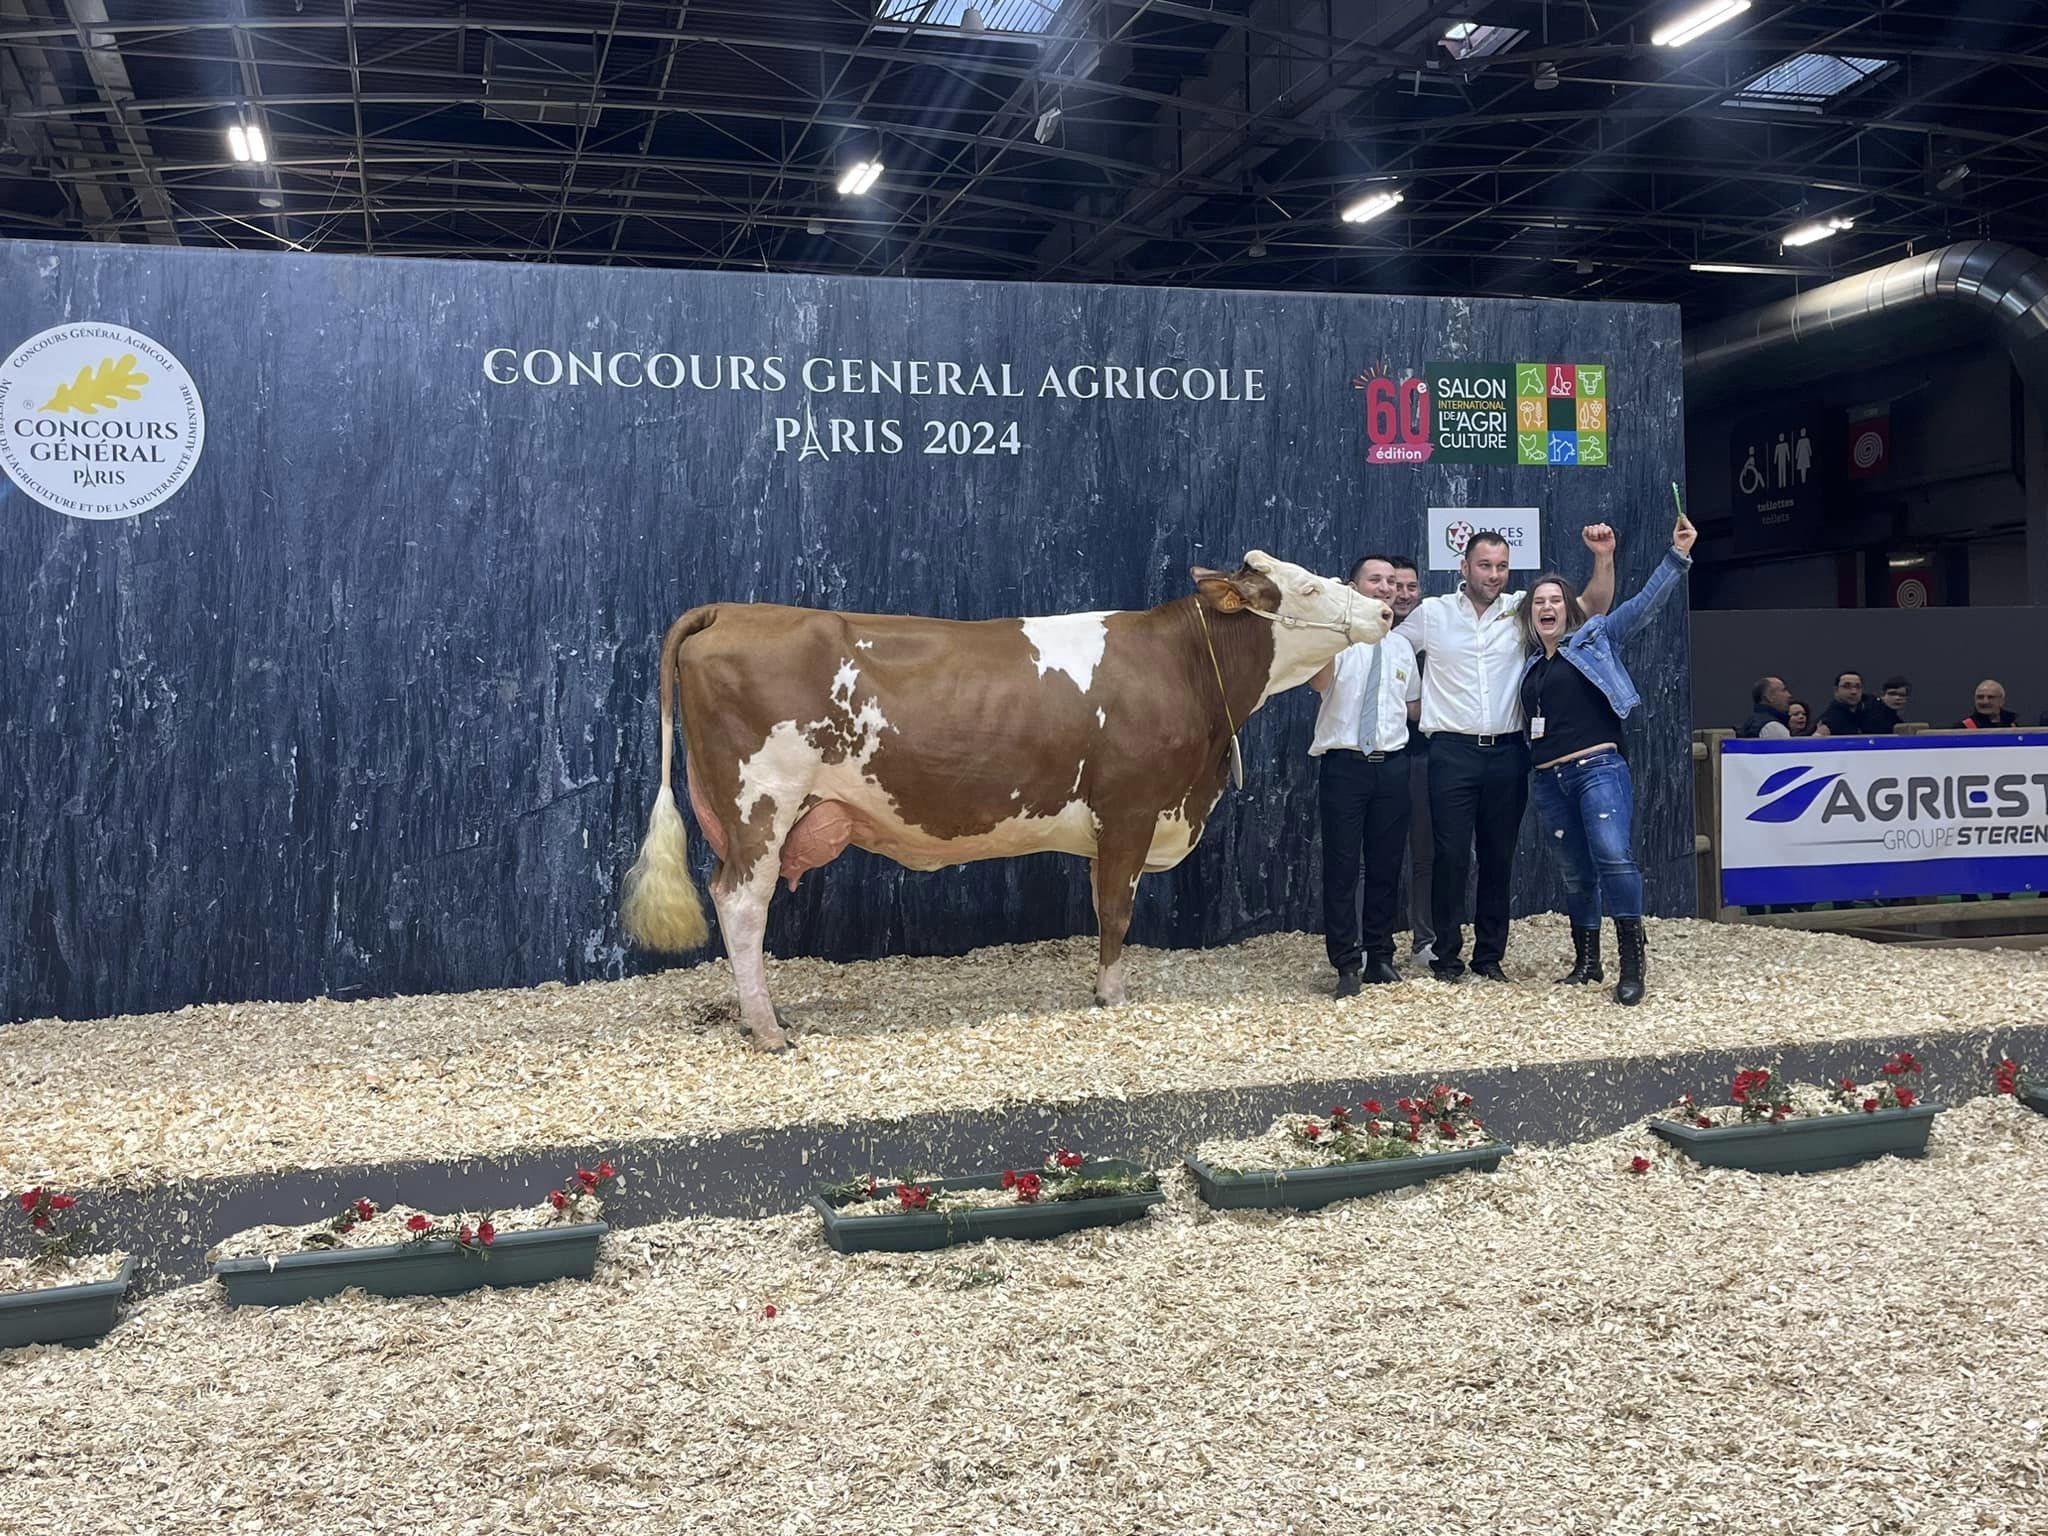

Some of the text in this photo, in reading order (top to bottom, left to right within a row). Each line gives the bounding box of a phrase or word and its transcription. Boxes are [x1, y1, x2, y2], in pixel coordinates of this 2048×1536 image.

[13, 327, 175, 373] CONCOURS GÉNÉRAL AGRICOLE
[483, 347, 1268, 403] CONCOURS GENERAL AGRICOLE
[1437, 377, 1507, 399] SALON
[1438, 399, 1507, 410] INTERNATIONAL
[1443, 411, 1456, 421] DE
[14, 418, 179, 440] CONCOURS
[775, 398, 1022, 462] PARIS 2024
[6, 453, 78, 509] L'AGRICULTURE
[79, 503, 94, 512] ET
[96, 504, 113, 513] DE
[115, 504, 129, 512] LA
[179, 383, 198, 452] ALIMENTAIRE
[30, 438, 166, 463] GÉNÉRAL
[1439, 433, 1507, 449] CULTURE
[1375, 446, 1422, 460] édition
[73, 463, 126, 489] PARIS
[1883, 827, 1954, 850] GROUPE
